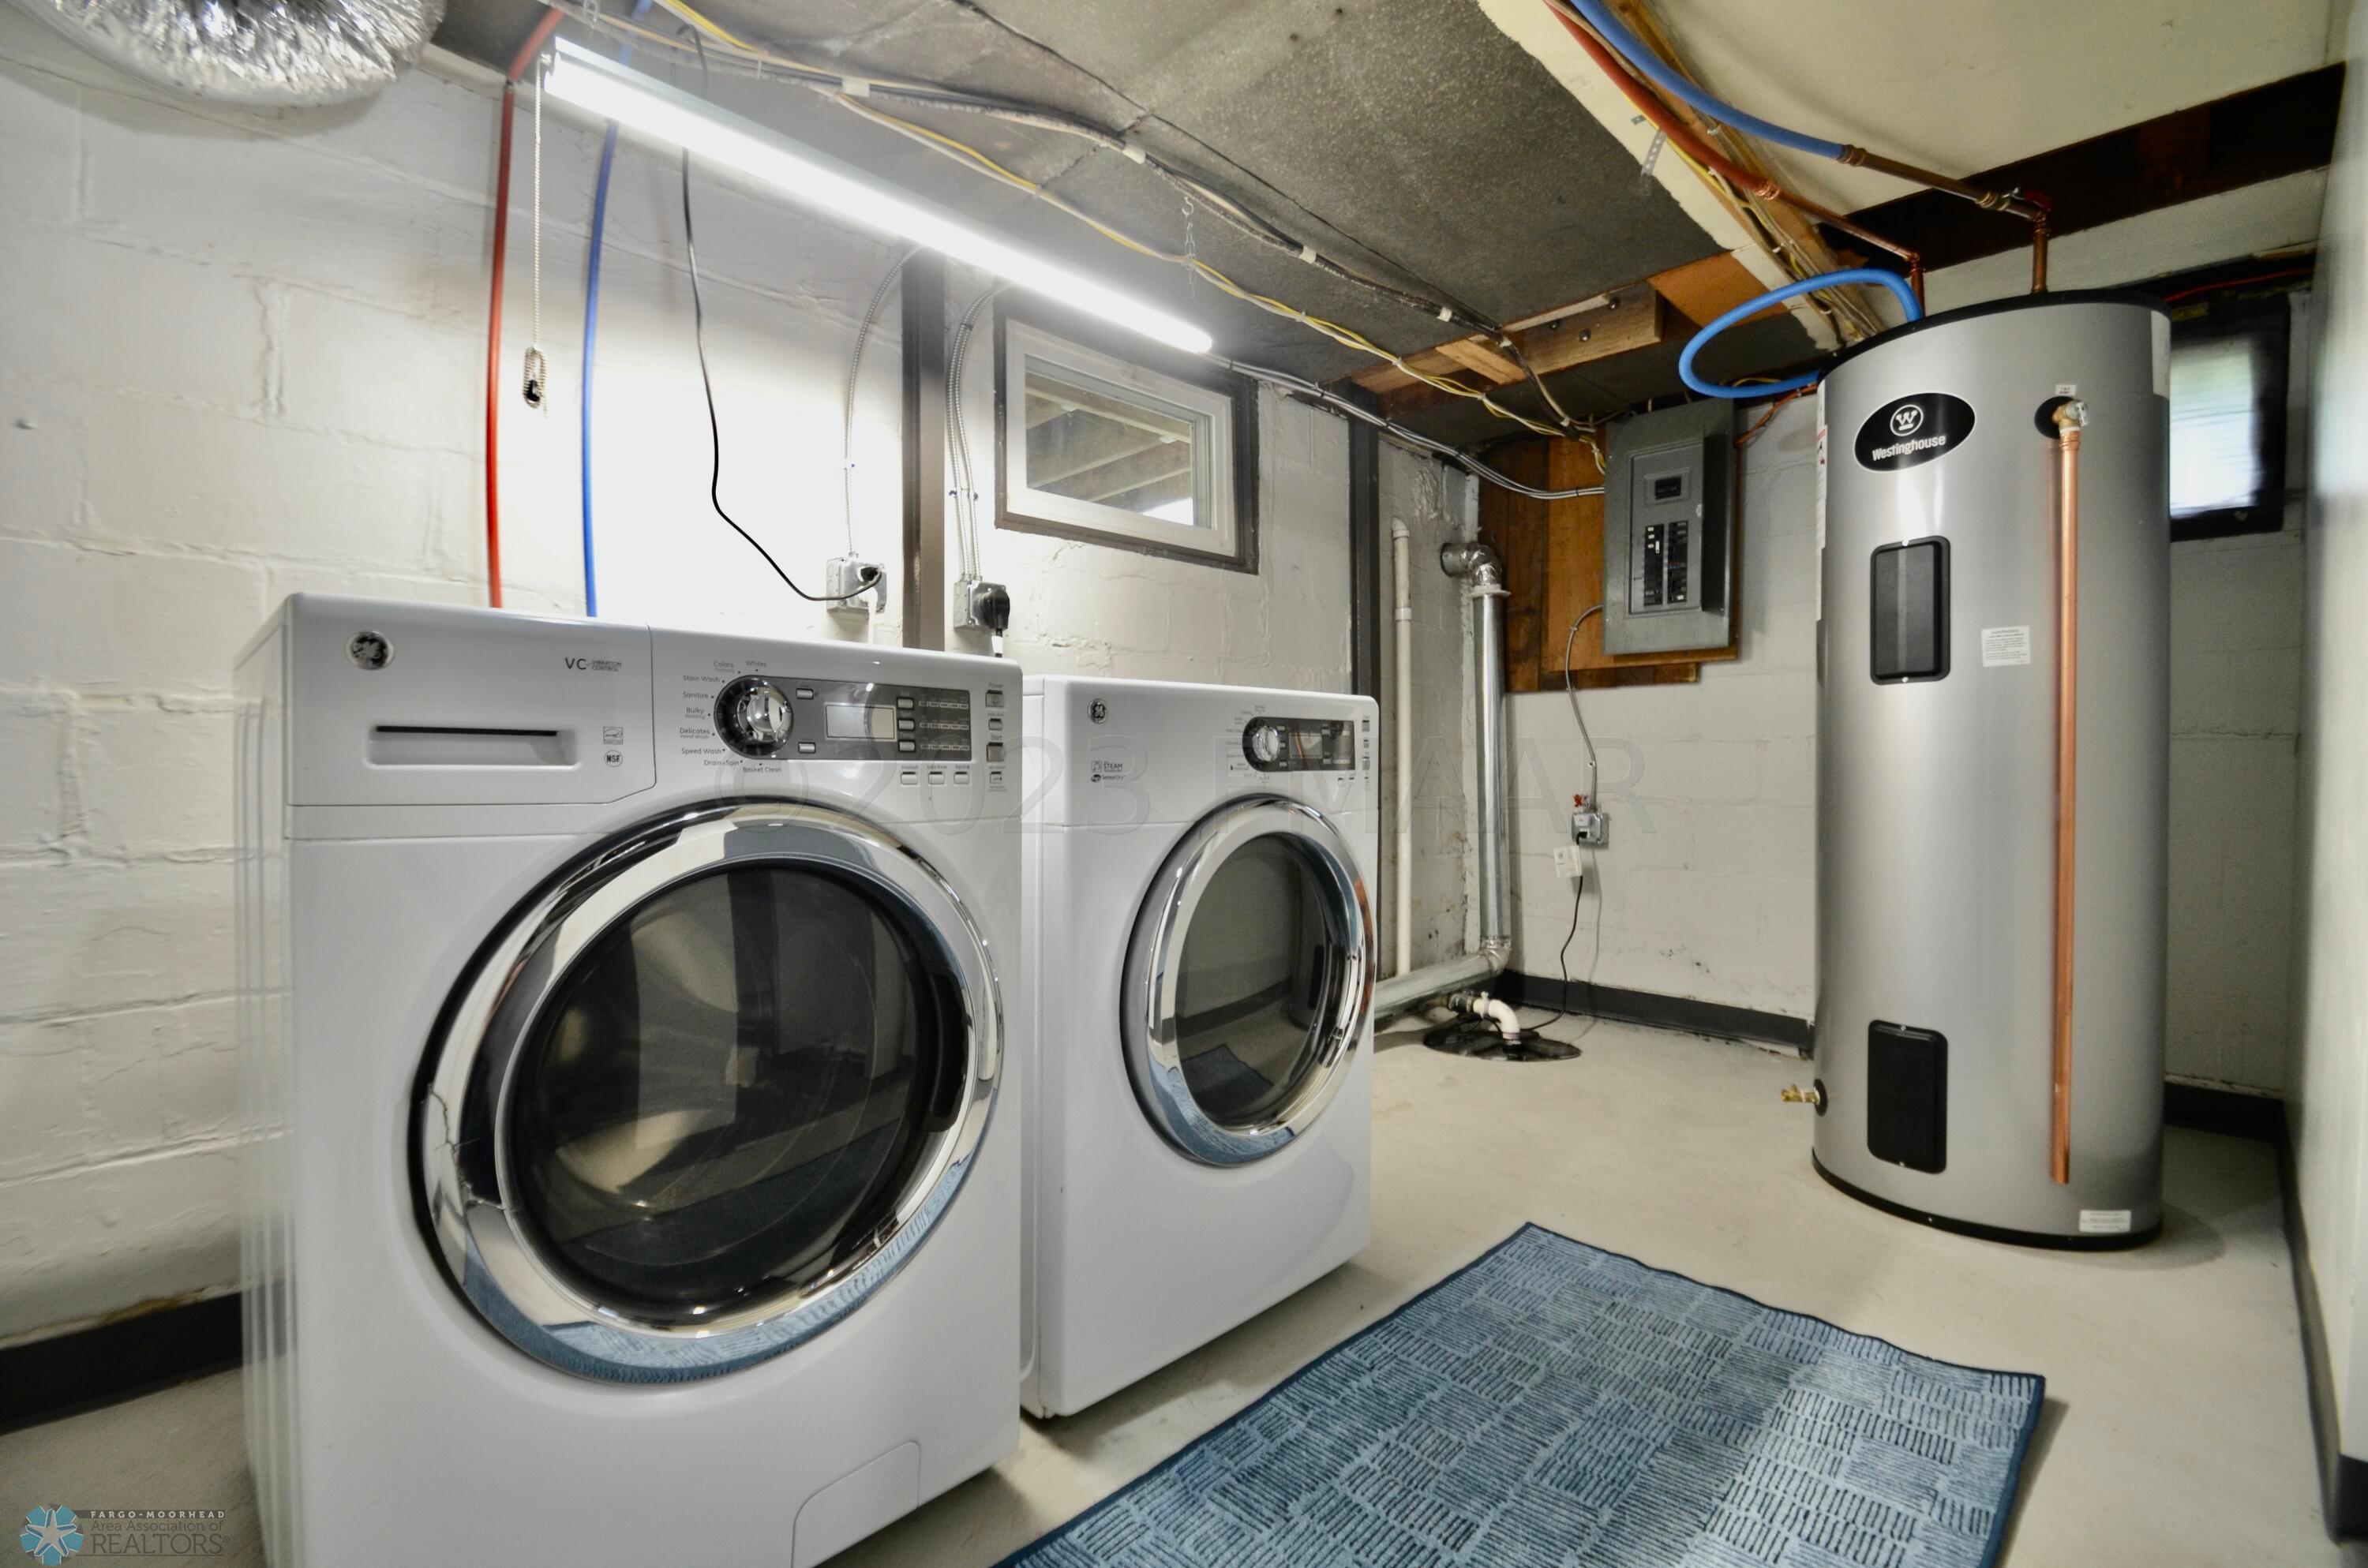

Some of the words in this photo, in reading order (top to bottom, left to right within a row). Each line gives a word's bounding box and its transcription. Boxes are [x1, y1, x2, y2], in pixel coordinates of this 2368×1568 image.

[1872, 436, 1946, 461] Westinghouse
[564, 657, 586, 670] VC
[606, 754, 620, 763] NSF
